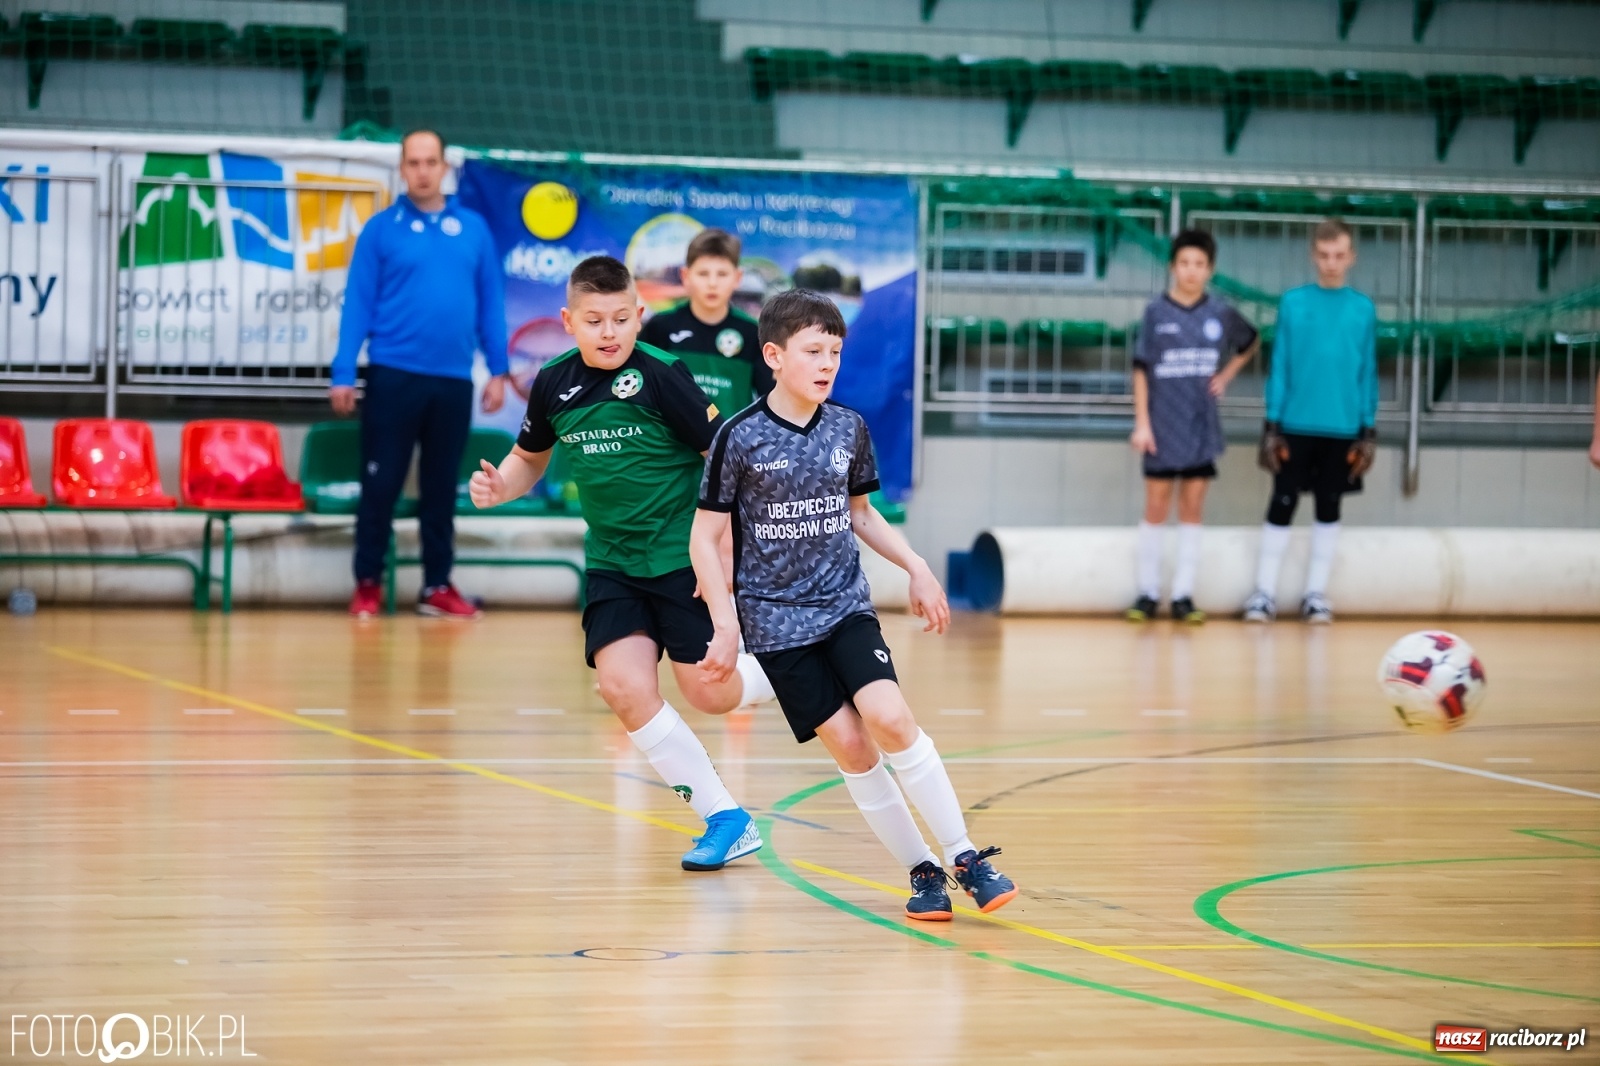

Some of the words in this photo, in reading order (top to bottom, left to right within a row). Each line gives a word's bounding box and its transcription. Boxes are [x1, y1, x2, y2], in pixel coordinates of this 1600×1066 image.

[560, 425, 643, 443] RESTAURACJA
[582, 441, 622, 455] BRAVO
[754, 519, 821, 540] RADOSŁAW
